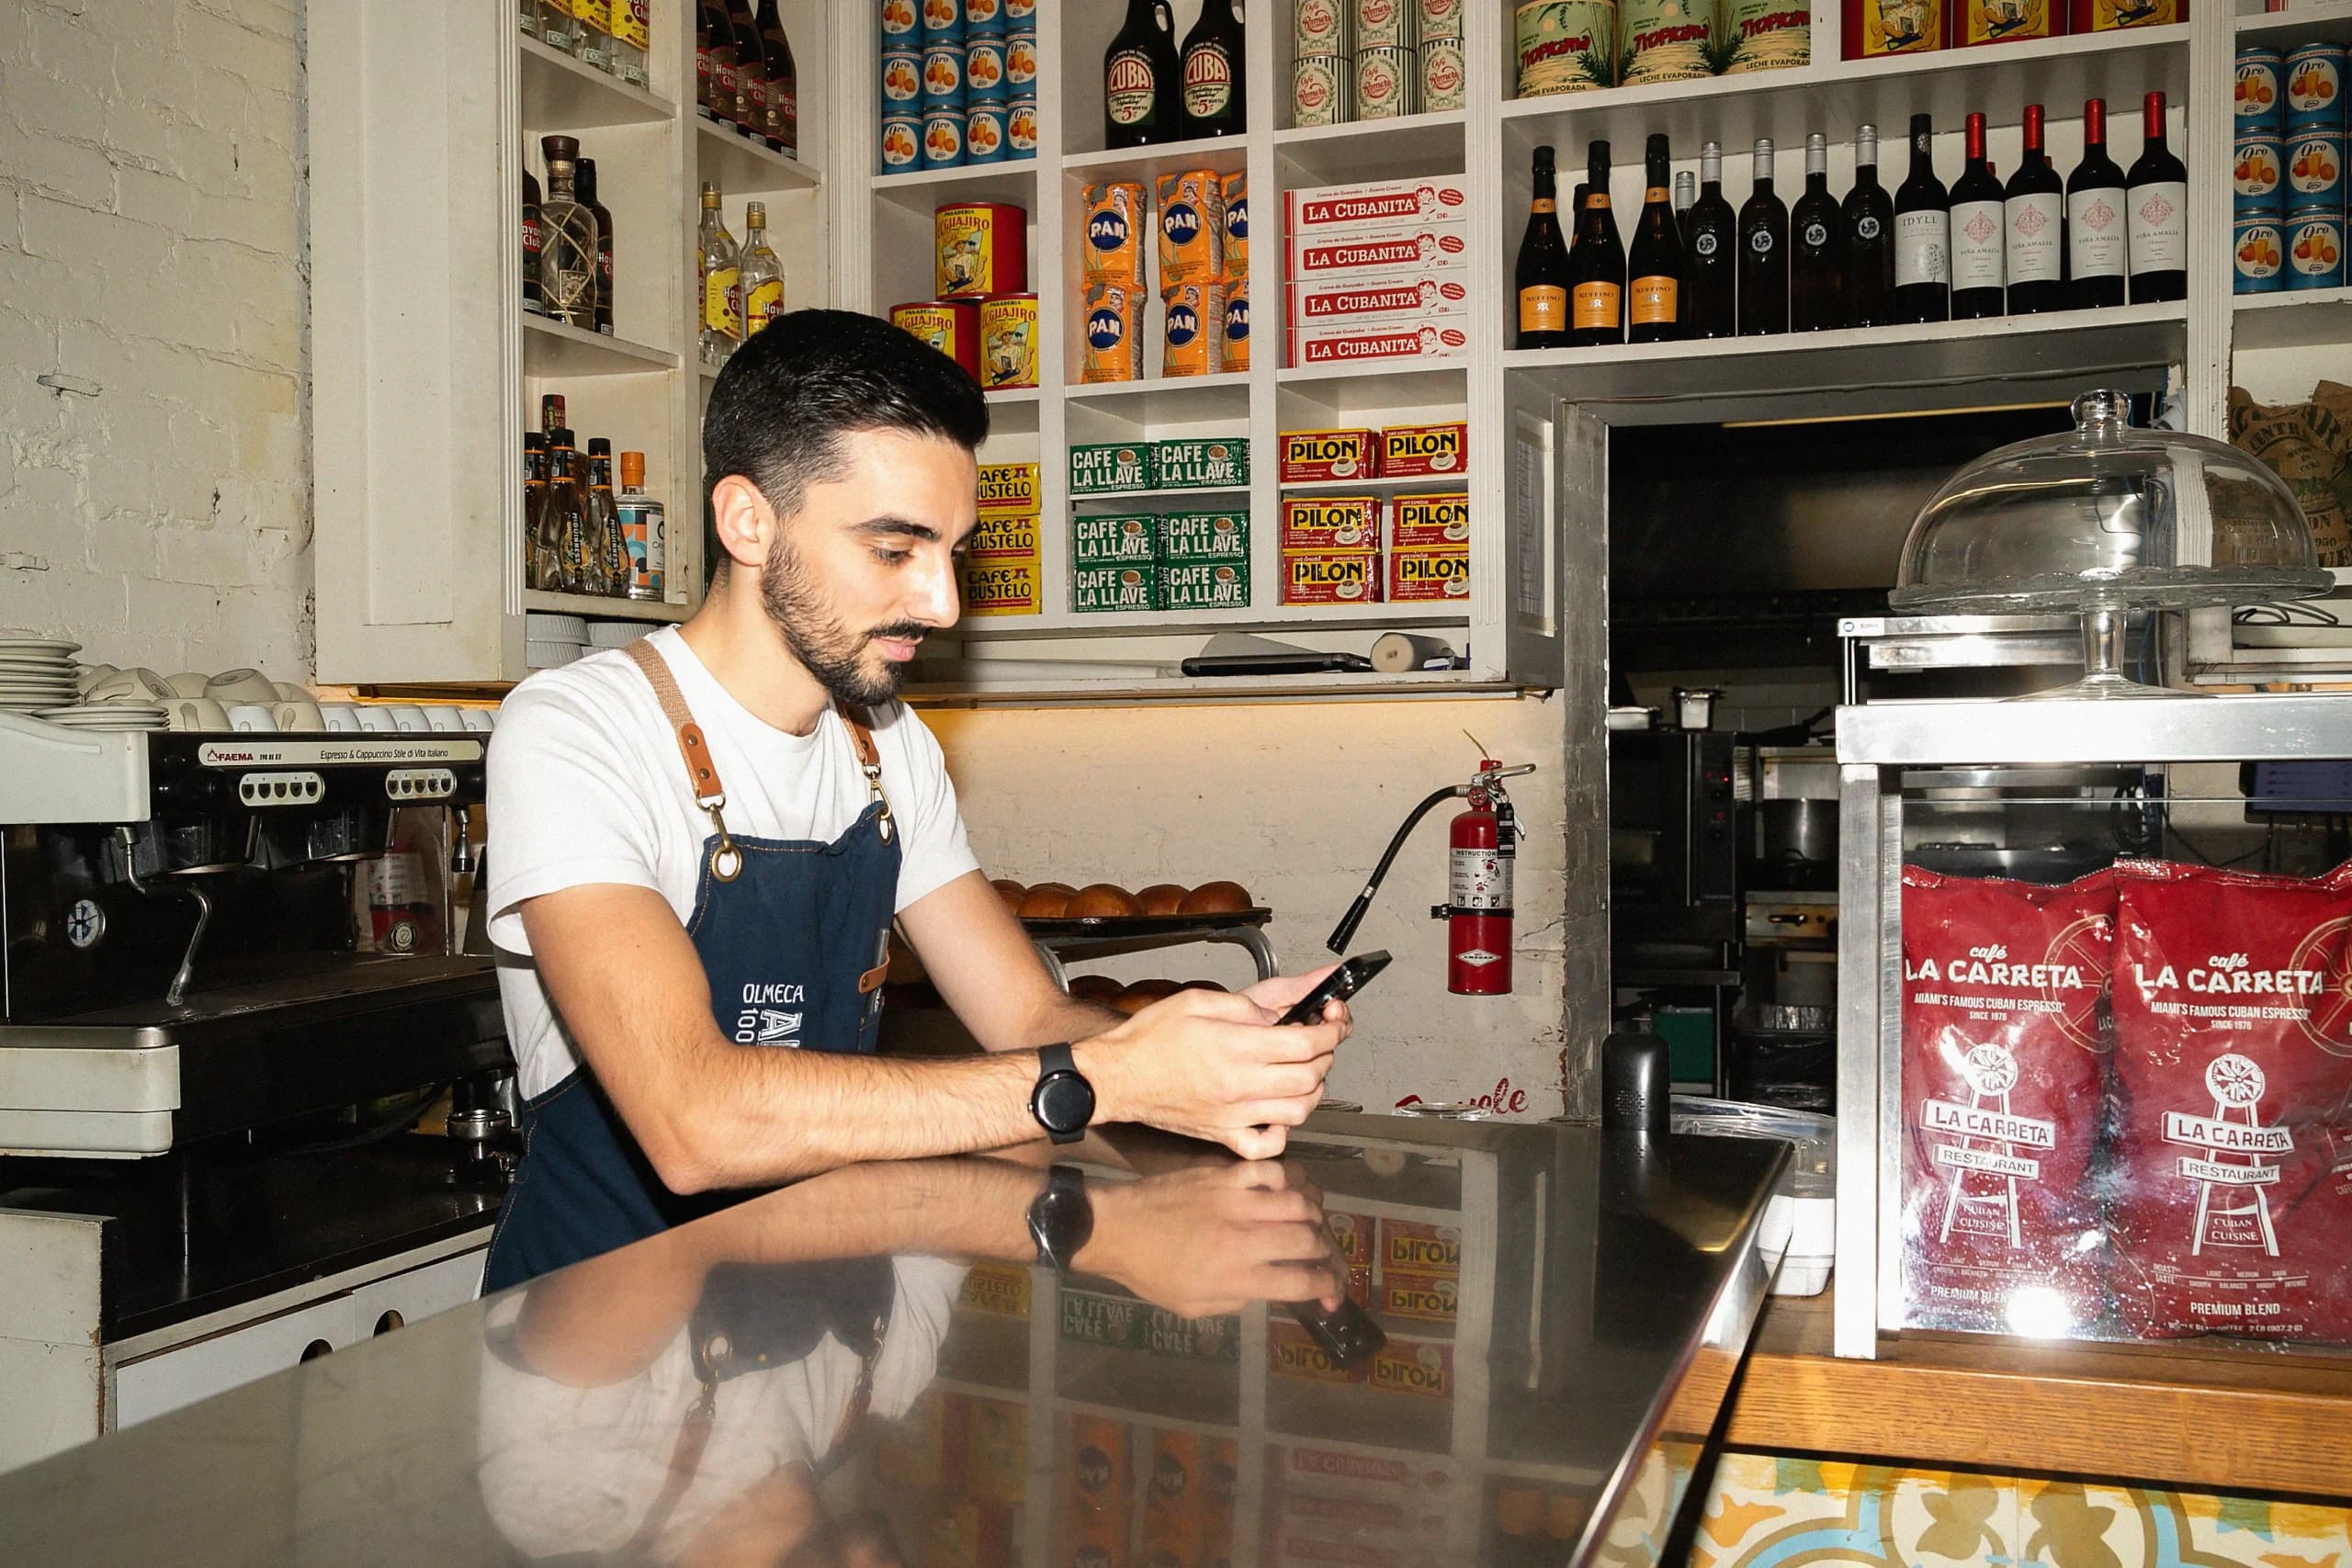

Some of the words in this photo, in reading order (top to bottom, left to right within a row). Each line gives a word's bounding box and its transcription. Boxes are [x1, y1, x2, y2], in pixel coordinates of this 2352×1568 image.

[973, 50, 991, 59] Oro
[1012, 43, 1028, 53] Oro
[891, 61, 910, 70] Oro
[931, 55, 948, 65] Oro
[1747, 61, 1768, 69] LECHE
[1770, 59, 1810, 67] EVAPORAD
[1110, 61, 1149, 91] CUBA
[1187, 54, 1225, 83] CUBA
[2239, 66, 2264, 80] Oro
[2299, 62, 2324, 75] Oro
[1639, 74, 1660, 83] LECHE
[1542, 85, 1586, 95] EVAPORADA
[1015, 109, 1033, 118] Oro
[1122, 107, 1131, 120] 5
[1198, 100, 1207, 114] 5
[932, 121, 949, 131] Oro
[973, 116, 990, 125] Oro
[889, 126, 907, 135] Oro
[2243, 148, 2267, 160] Oro
[2301, 142, 2327, 156] Oro
[1308, 207, 1329, 220] LA
[1335, 198, 1415, 218] CUBANITA
[944, 217, 989, 231] GUAJIRO
[1903, 216, 1938, 227] IDYLL
[2248, 230, 2272, 242] Oro
[2303, 225, 2329, 238] Oro
[1309, 253, 1330, 266] LA
[1336, 245, 1415, 264] CUBANITA
[1310, 299, 1331, 312] LA
[1338, 292, 1417, 310] CUBANITA
[989, 309, 1036, 321] GUAJIRO
[904, 317, 952, 330] GUAJIRO
[1311, 344, 1332, 358] LA
[1338, 339, 1418, 355] CUBANITA
[1290, 440, 1357, 460] PILON
[1390, 434, 1456, 456] PILON
[1073, 451, 1111, 469] CAFE
[1161, 446, 1202, 464] CAFE
[1073, 469, 1092, 487] LA
[1097, 467, 1143, 485] LLAVE
[1162, 464, 1182, 481] LA
[1187, 462, 1234, 480] LLAVE
[979, 482, 1031, 499] USTELO
[1294, 508, 1362, 527] PILON
[1078, 521, 1117, 539] CAFE
[1170, 518, 1209, 536] CAFE
[971, 533, 1034, 549] BUSTELO
[1078, 540, 1098, 558] LA
[1102, 537, 1149, 557] LLAVE
[1170, 537, 1190, 554] LA
[1194, 535, 1240, 553] LLAVE
[1077, 570, 1115, 589] CAFE
[1170, 567, 1210, 585] CAFE
[1295, 563, 1363, 581] PILON
[1077, 589, 1097, 606] LA
[1102, 587, 1148, 604] LLAVE
[1170, 586, 1191, 604] LA
[1195, 584, 1241, 603] LLAVE
[219, 752, 254, 761] FAEMA
[320, 750, 346, 760] Espresso
[356, 749, 392, 760] Cappuccino
[394, 749, 406, 758] Stile
[408, 749, 413, 757] di
[414, 749, 426, 758] Vita
[427, 748, 448, 757] Italiano
[1970, 944, 2007, 963] café
[2209, 953, 2249, 972] café
[1905, 959, 1940, 981] LA
[1948, 960, 2083, 988] CARRETA
[2135, 964, 2179, 988] LA
[2188, 968, 2323, 994] CARRETA
[743, 984, 804, 1003] OLMECA
[1915, 993, 1948, 1005] MIAMI'S
[1950, 995, 1984, 1009] FAMOUS
[1986, 998, 2016, 1010] CUBAN
[2018, 999, 2062, 1012] ESPRESSO
[1969, 1011, 1988, 1020] SINCE
[2151, 1002, 2188, 1015] MIAMI'S
[2189, 1005, 2227, 1017] FAMOUS
[2228, 1006, 2260, 1018] CUBAN
[2262, 1007, 2309, 1021] ESPRESSO
[2211, 1020, 2233, 1029] SINCE
[1936, 1107, 1961, 1126] LA
[1967, 1115, 2048, 1143] CARRETA
[2178, 1120, 2205, 1140] LA
[2212, 1128, 2290, 1147] CARRETA
[2189, 1163, 2276, 1180] RESTAURANT
[1961, 1218, 2005, 1229] CUISINE
[2213, 1218, 2252, 1228] CUBAN
[2211, 1231, 2258, 1241] CUISINE
[1931, 1287, 1979, 1301] PREMIUM
[2190, 1302, 2242, 1315] PREMIUM
[2245, 1303, 2280, 1315] BLEND
